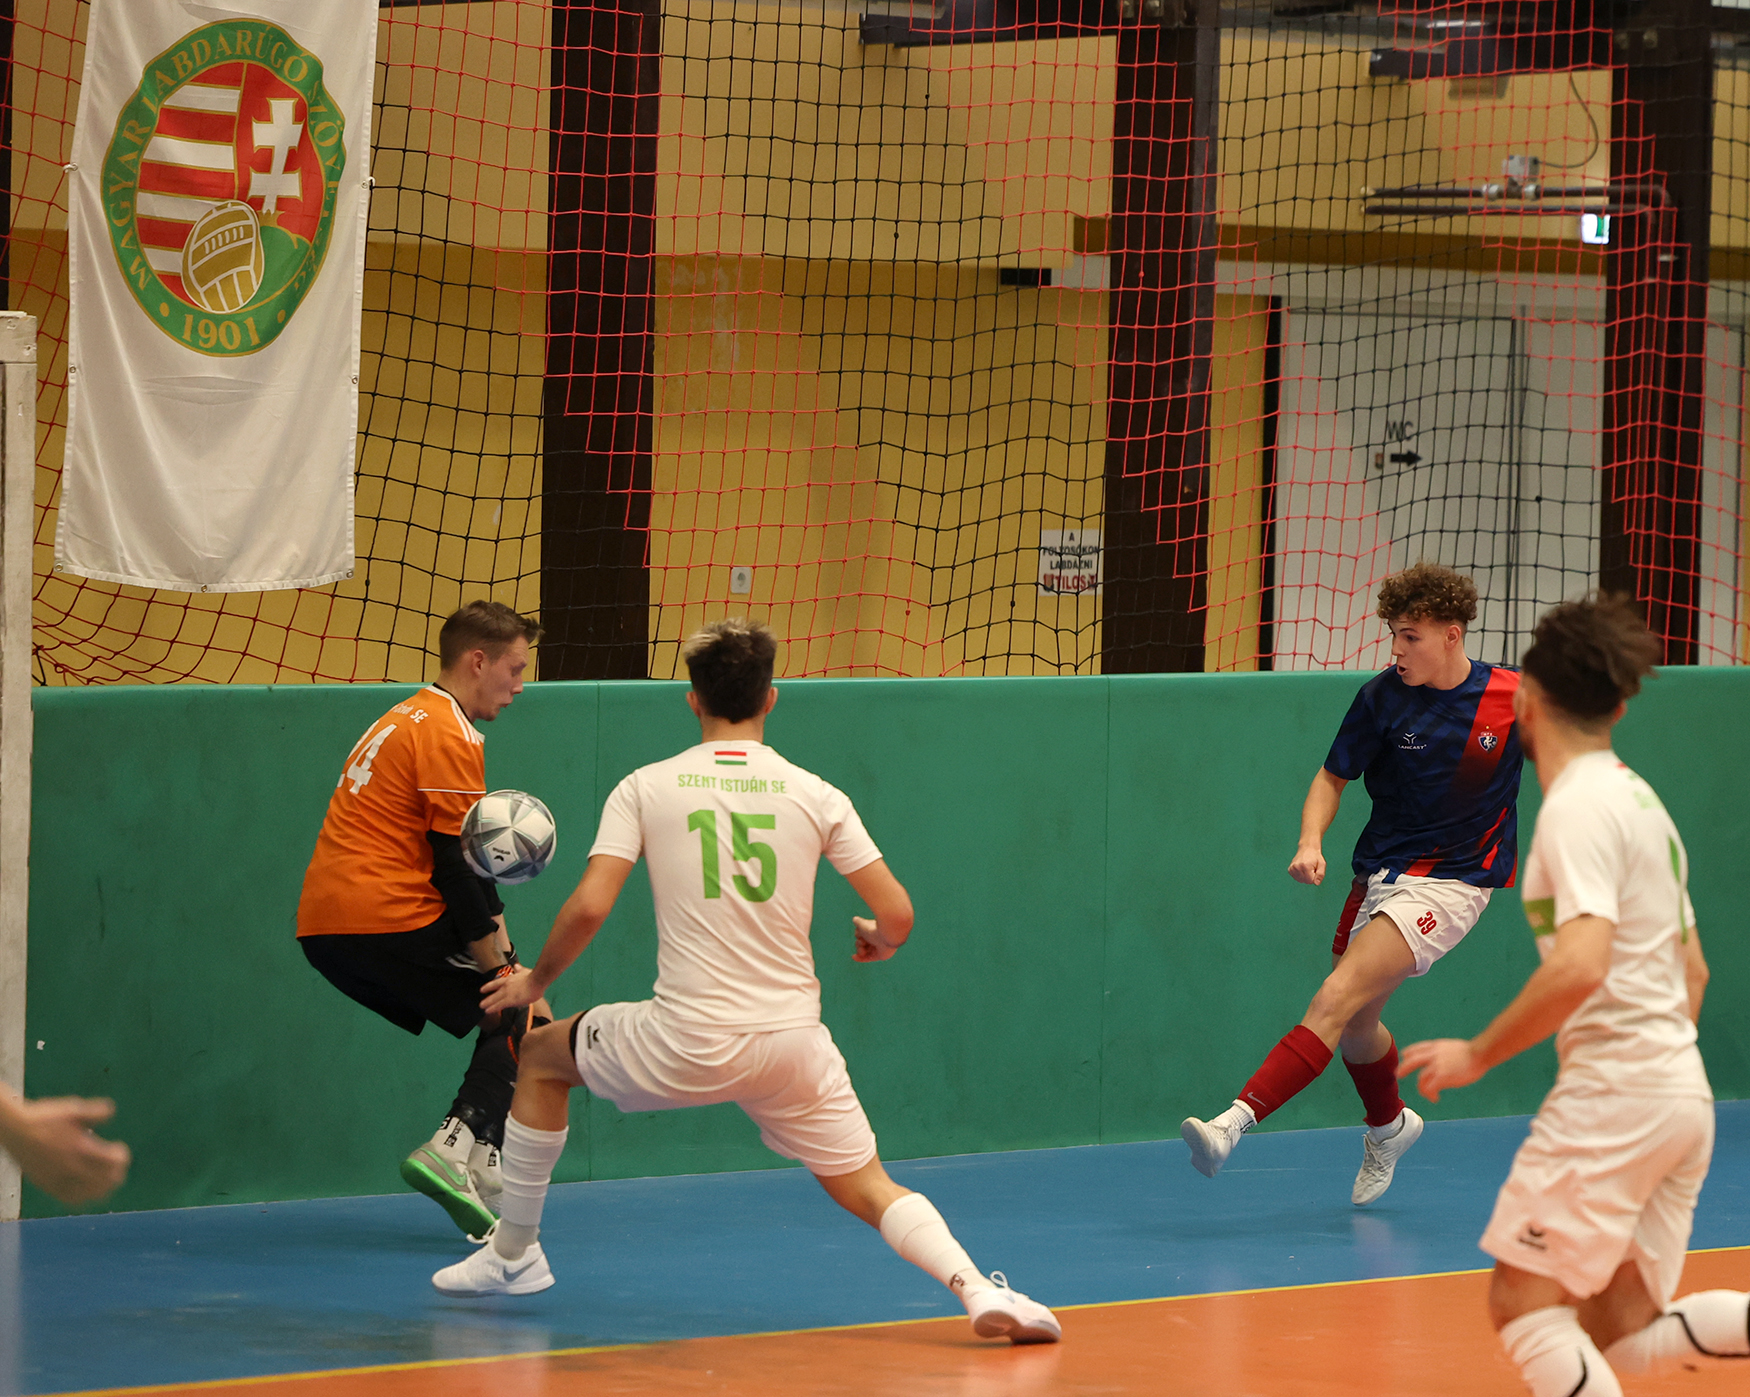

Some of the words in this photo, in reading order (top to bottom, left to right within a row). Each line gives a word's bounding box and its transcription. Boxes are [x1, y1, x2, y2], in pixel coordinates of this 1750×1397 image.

[108, 118, 152, 291] MAGYAR
[140, 25, 314, 117] LABDARÚGÓ
[181, 313, 261, 350] 1901
[1386, 420, 1414, 441] WC
[1068, 531, 1075, 542] A
[410, 708, 429, 724] SE
[677, 774, 717, 789] SZENT
[720, 776, 768, 793] ISTVÁN
[771, 780, 787, 793] SE
[687, 809, 777, 903] 15
[1416, 910, 1437, 936] 39
